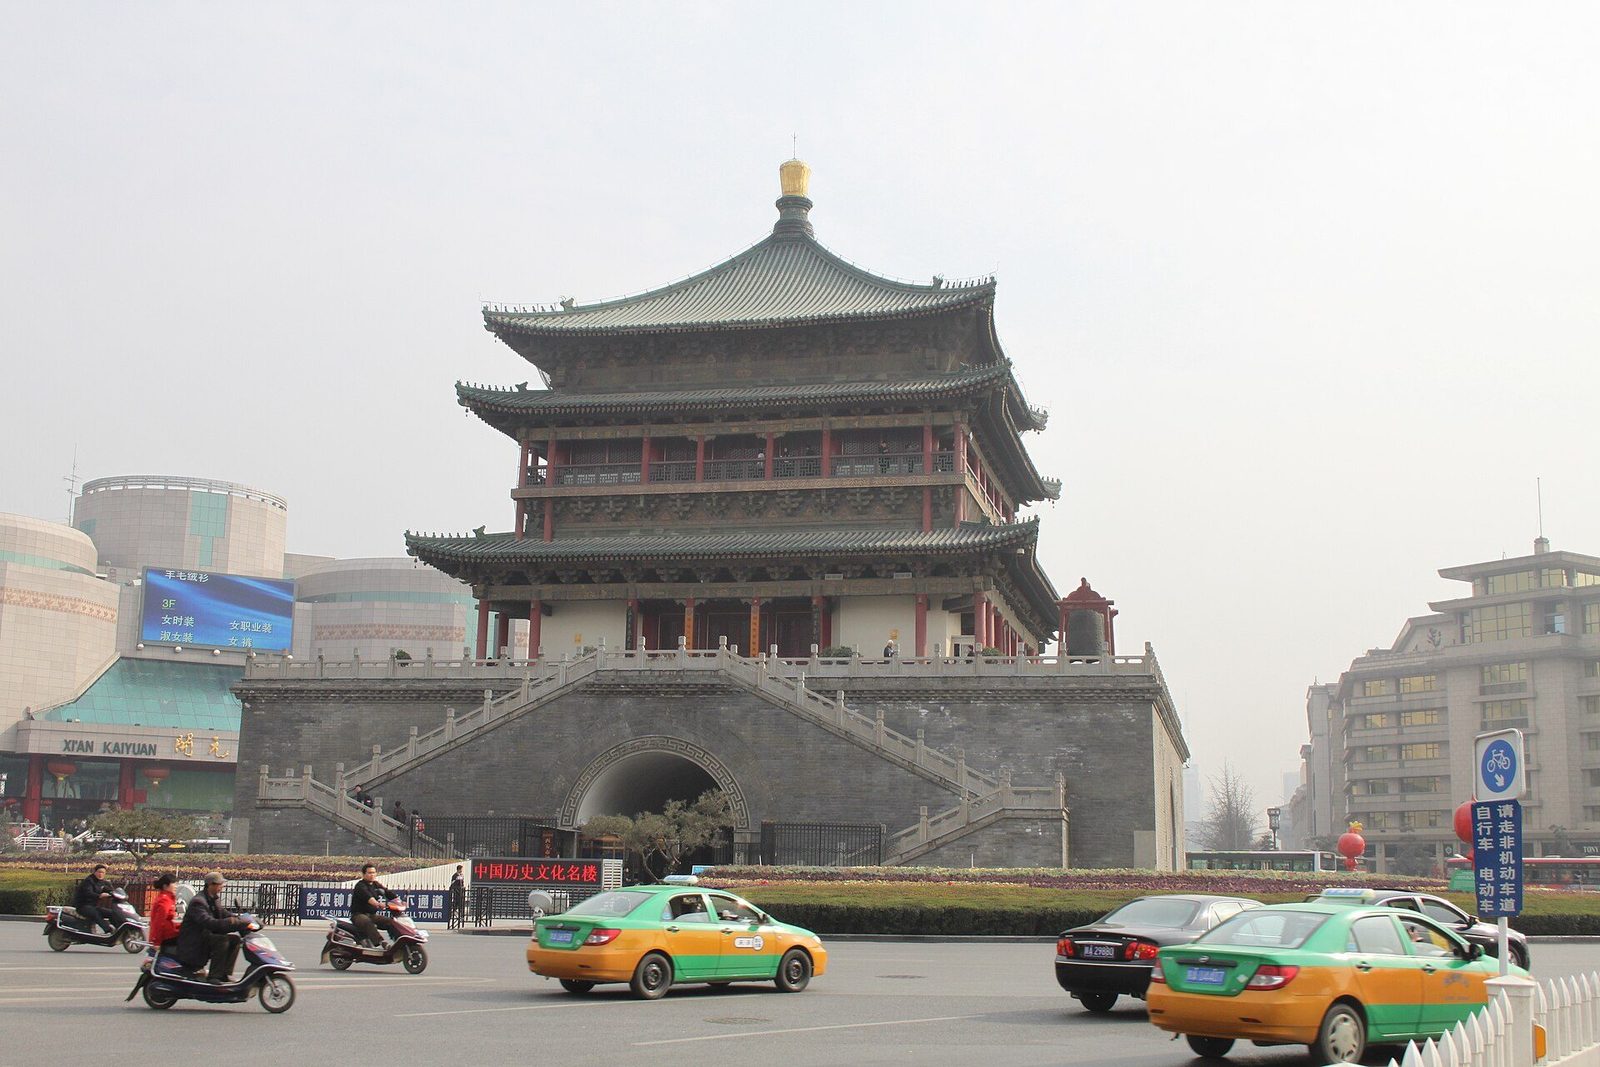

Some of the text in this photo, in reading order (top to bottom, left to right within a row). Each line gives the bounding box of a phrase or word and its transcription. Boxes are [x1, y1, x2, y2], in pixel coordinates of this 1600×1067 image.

[162, 599, 176, 608] 3F
[162, 615, 195, 627] 女时装
[229, 620, 272, 634] 女职业装
[160, 631, 193, 643] 淑女装
[63, 739, 157, 756] XI'AN KAIYUAN
[1476, 806, 1495, 913] 自行车 电动车
[1497, 805, 1516, 912] 请走非机动车道
[474, 863, 598, 882] 中国历史文化名楼
[306, 909, 315, 917] TO
[418, 911, 443, 919] TOWER
